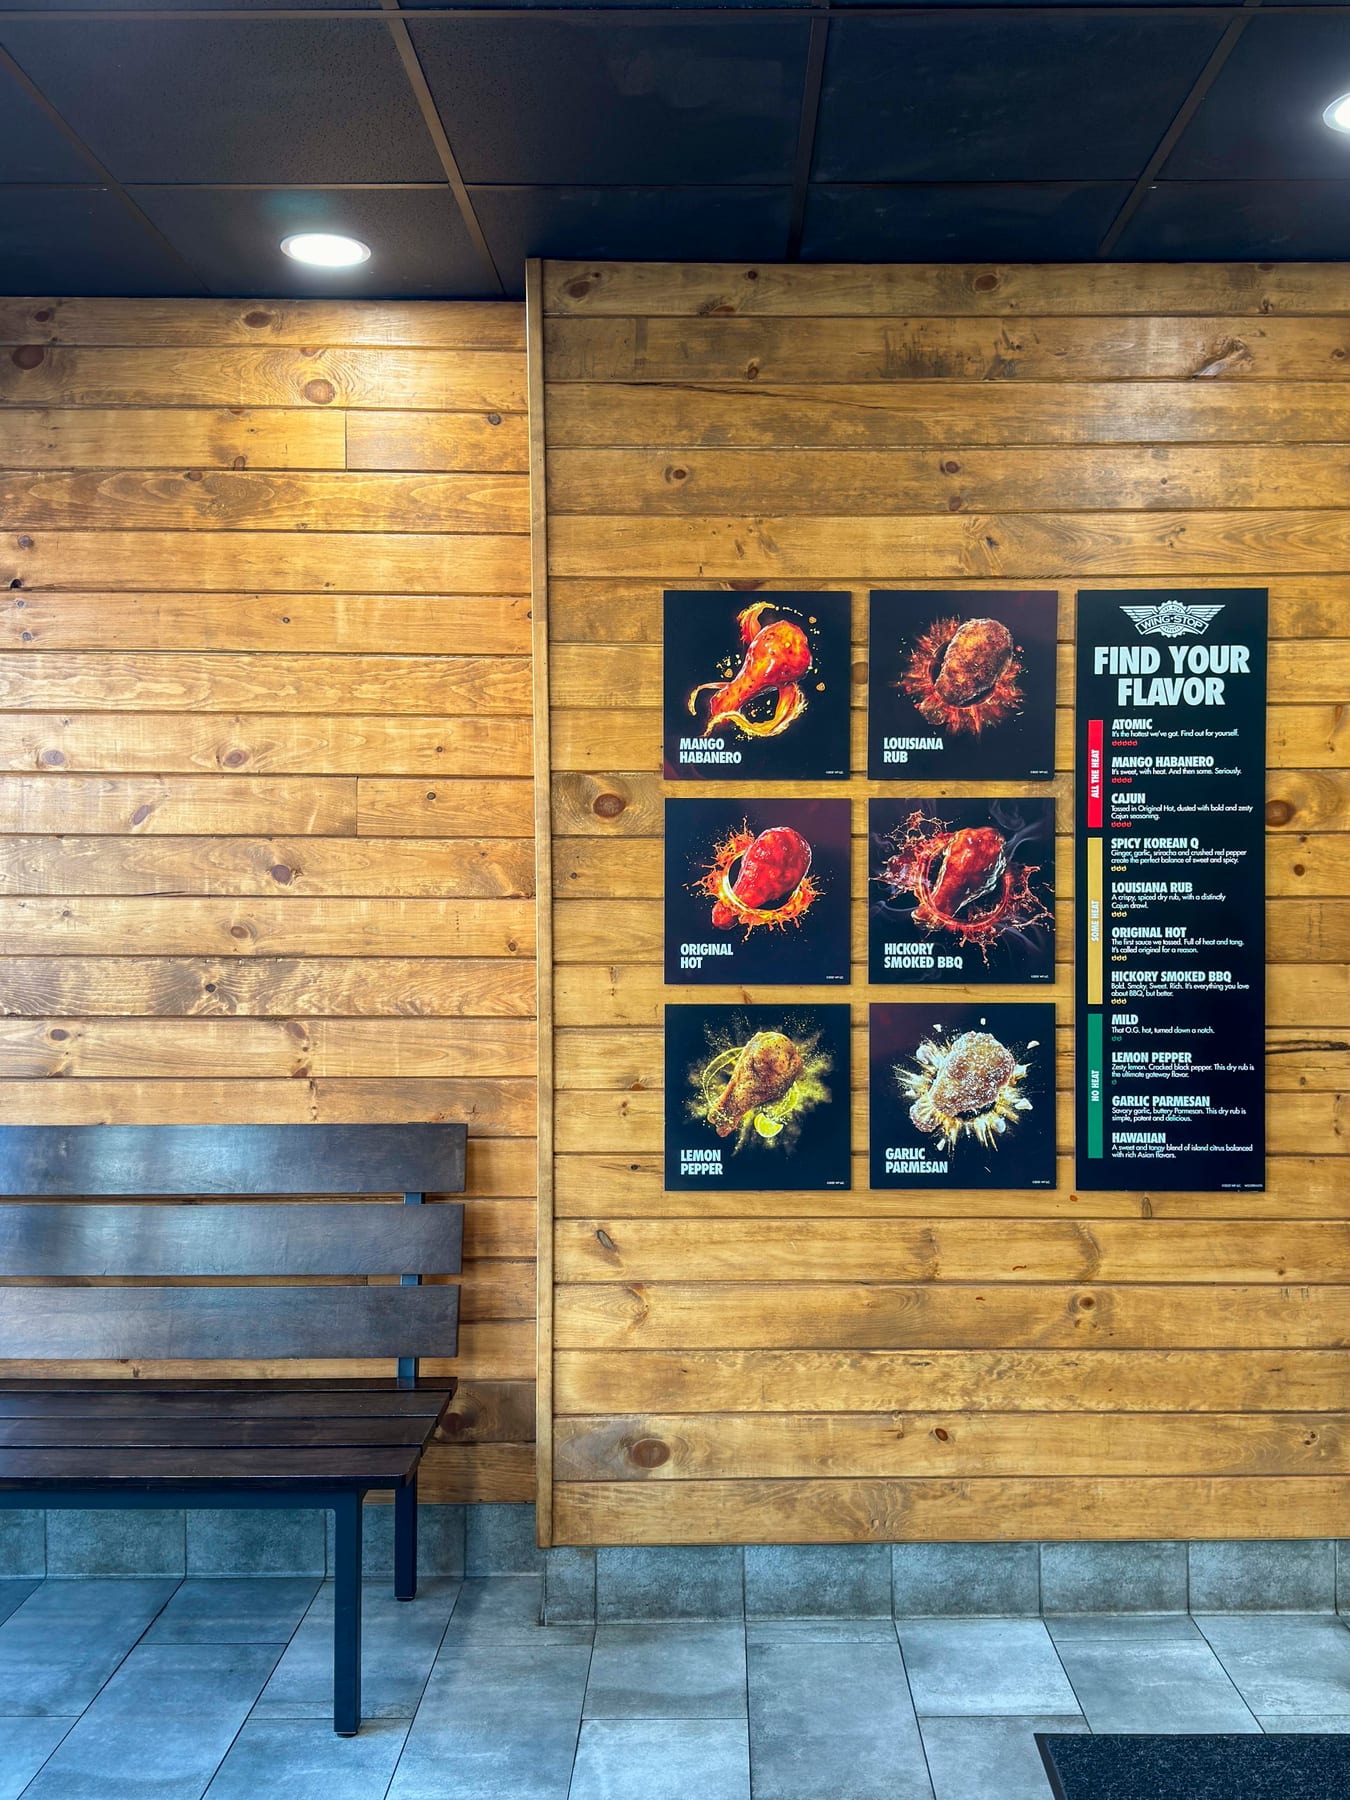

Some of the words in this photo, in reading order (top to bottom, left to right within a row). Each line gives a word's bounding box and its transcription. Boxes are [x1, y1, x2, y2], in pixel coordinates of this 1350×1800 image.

[1094, 646, 1161, 675] FIND
[1168, 645, 1250, 674] YOUR
[1118, 677, 1226, 706] FLAVOR
[1112, 719, 1153, 730] ATOMIC
[679, 738, 725, 750] MANGO
[883, 737, 944, 750] LOUISIANA
[679, 751, 742, 764] HABANERO
[883, 751, 908, 763] RUB
[1111, 756, 1153, 767] MANGO
[1155, 756, 1214, 767] HABANERO
[1111, 793, 1146, 804] CAJUN
[1110, 838, 1141, 849] SPICY
[1144, 838, 1188, 849] KOREAN
[1190, 838, 1199, 849] Q
[1111, 882, 1168, 893] LOUISIANA
[1170, 882, 1193, 893] RUB
[1112, 927, 1162, 938] ORIGINAL
[1165, 927, 1187, 938] HOT
[680, 943, 734, 956] ORIGINAL
[884, 943, 934, 955] HICKORY
[680, 957, 703, 969] HOT
[884, 956, 934, 969] SMOKED
[937, 956, 963, 970] BBQ
[1111, 971, 1159, 982] HICKORY
[1161, 971, 1206, 982] SMOKED
[1208, 971, 1232, 982] BBQ
[1111, 1014, 1139, 1025] MILD
[1112, 1052, 1149, 1063] LEMON
[1151, 1052, 1192, 1063] PEPPER
[1112, 1096, 1150, 1107] GARLIC
[1152, 1096, 1210, 1107] PARMESAN
[1112, 1132, 1166, 1144] HAWAIIAN
[680, 1149, 721, 1162] LEMON
[885, 1147, 925, 1160] GARLIC
[680, 1163, 723, 1175] PEPPER
[885, 1161, 948, 1174] PARMESAN
